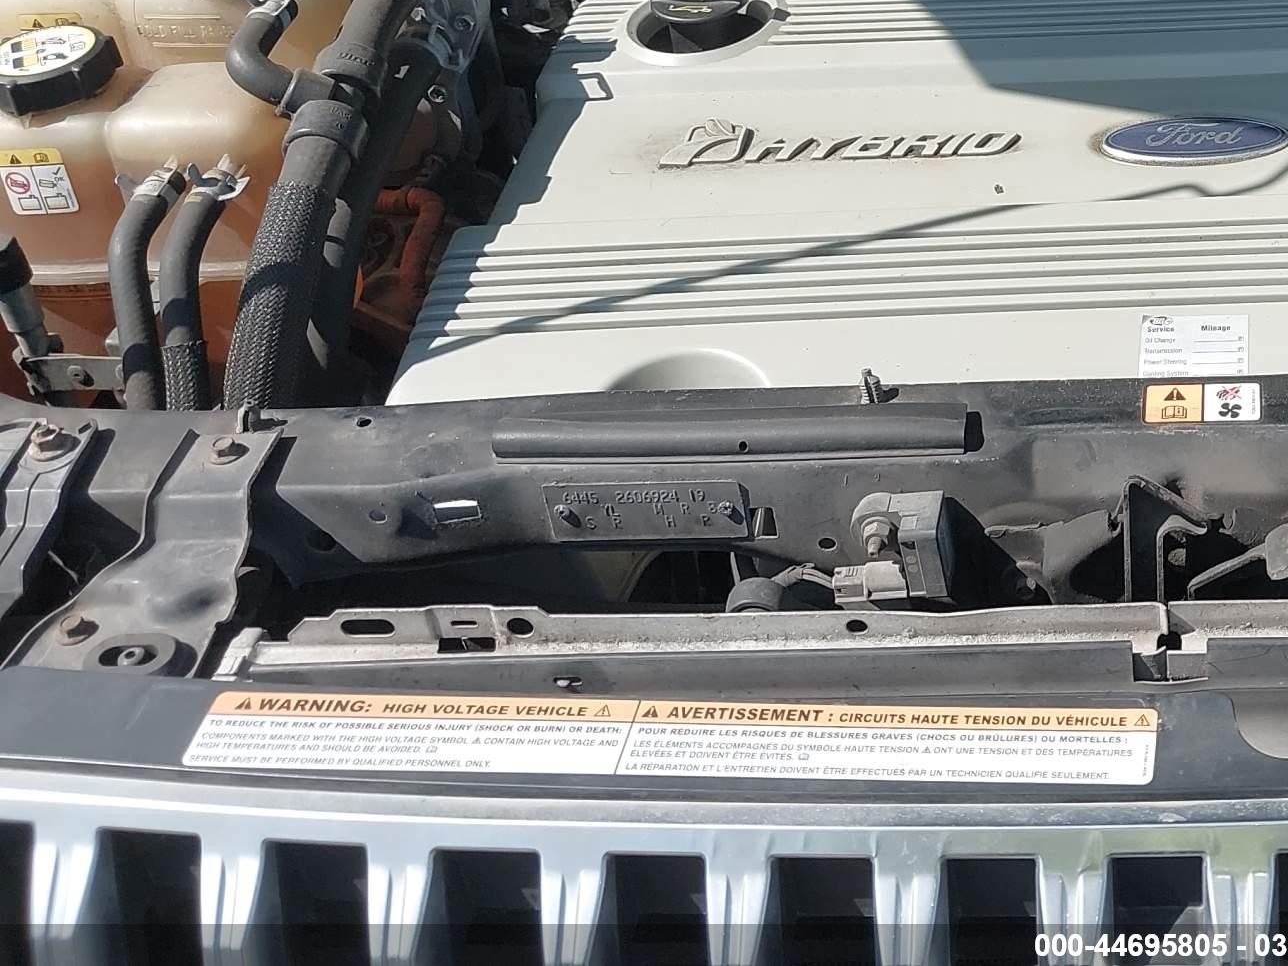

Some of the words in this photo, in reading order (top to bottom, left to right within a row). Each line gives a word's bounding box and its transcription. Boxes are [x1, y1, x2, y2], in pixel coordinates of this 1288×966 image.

[1145, 120, 1244, 150] Ford
[745, 129, 1023, 163] HYBRID
[615, 490, 680, 504] 2606924
[259, 698, 372, 713] WARNING:
[382, 703, 428, 714] HIGH
[432, 704, 510, 716] VOLTAGE
[516, 705, 590, 717] VEHICLE
[667, 707, 824, 722] AVERTISSEMENT
[839, 713, 906, 724] CIRCUITS
[911, 715, 959, 725] HAUTE
[964, 715, 1026, 726] TENSION
[1031, 716, 1051, 726] DU
[1056, 714, 1128, 727] VÉHICULE
[807, 731, 867, 739] BLESSURES
[1059, 735, 1121, 743] MORTELLES
